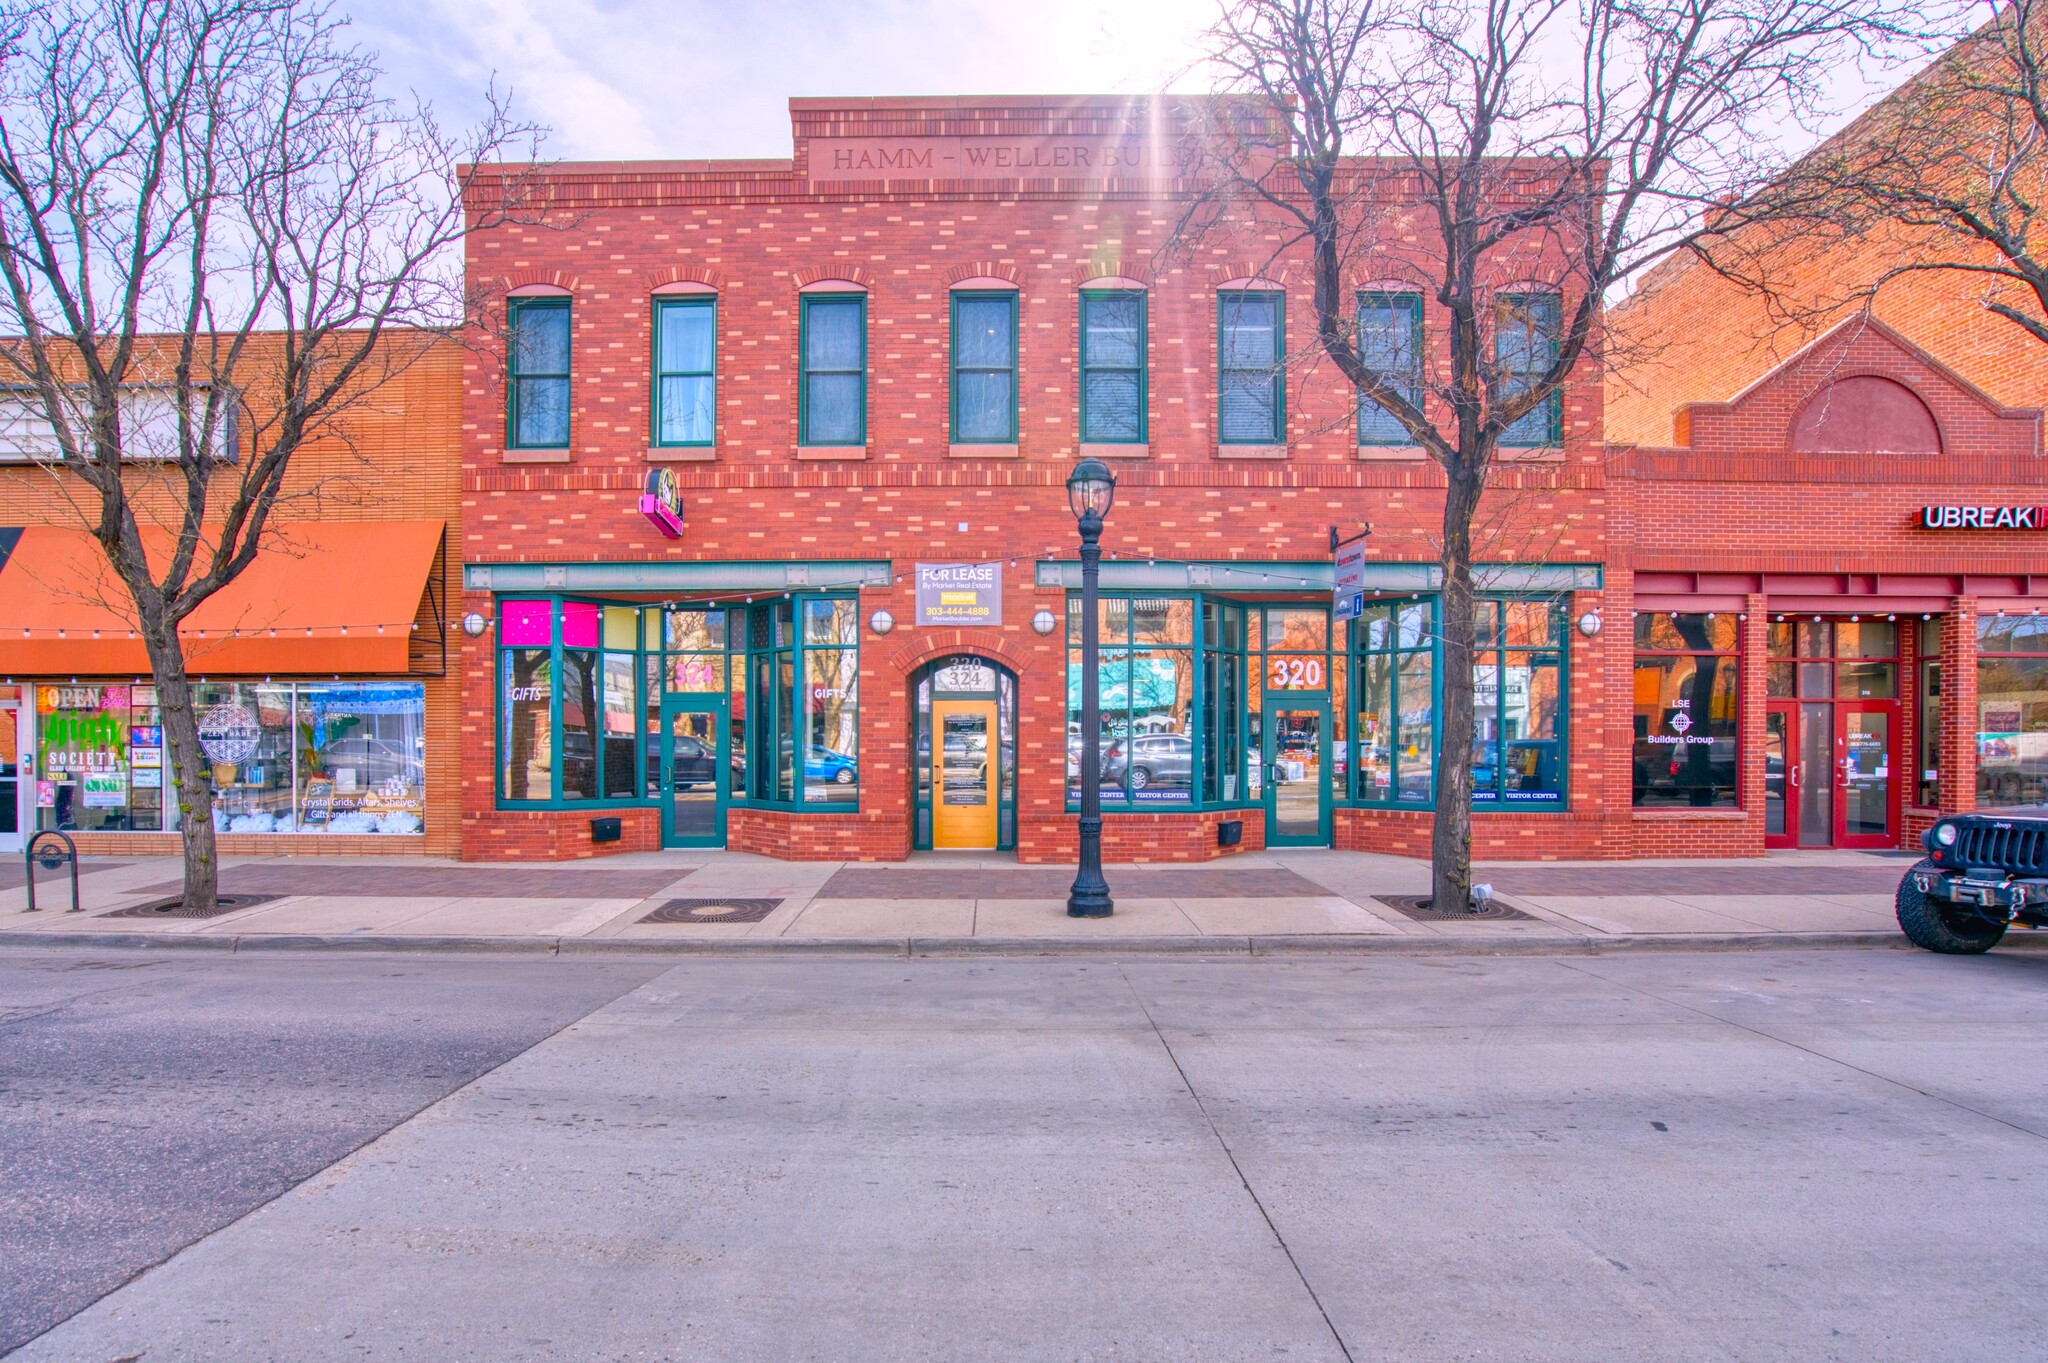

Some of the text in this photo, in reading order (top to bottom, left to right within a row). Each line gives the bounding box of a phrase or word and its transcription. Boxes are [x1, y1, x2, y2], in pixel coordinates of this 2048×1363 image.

[833, 148, 933, 169] HAMM
[965, 146, 1092, 168] WELLER
[922, 568, 993, 581] FOR LEASE
[922, 582, 931, 590] By
[944, 593, 974, 601] market
[926, 607, 990, 616] 303-444-4888
[949, 657, 982, 671] 320
[674, 663, 714, 685] 324
[949, 671, 982, 685] 324
[1274, 659, 1320, 686] 320
[47, 687, 100, 708] OPEN
[512, 687, 542, 701] GIFTS
[814, 689, 847, 699] GIFTS
[1672, 700, 1690, 708] LSE
[207, 729, 252, 737] ZEN BABE
[1647, 735, 1714, 746] Builders Group
[49, 751, 117, 765] SOCIETY
[301, 797, 419, 808] Crystal Grids, Altars, Shelves,
[311, 809, 402, 821] Gifts and all things ZEN
[1993, 821, 2012, 830] Jeep
